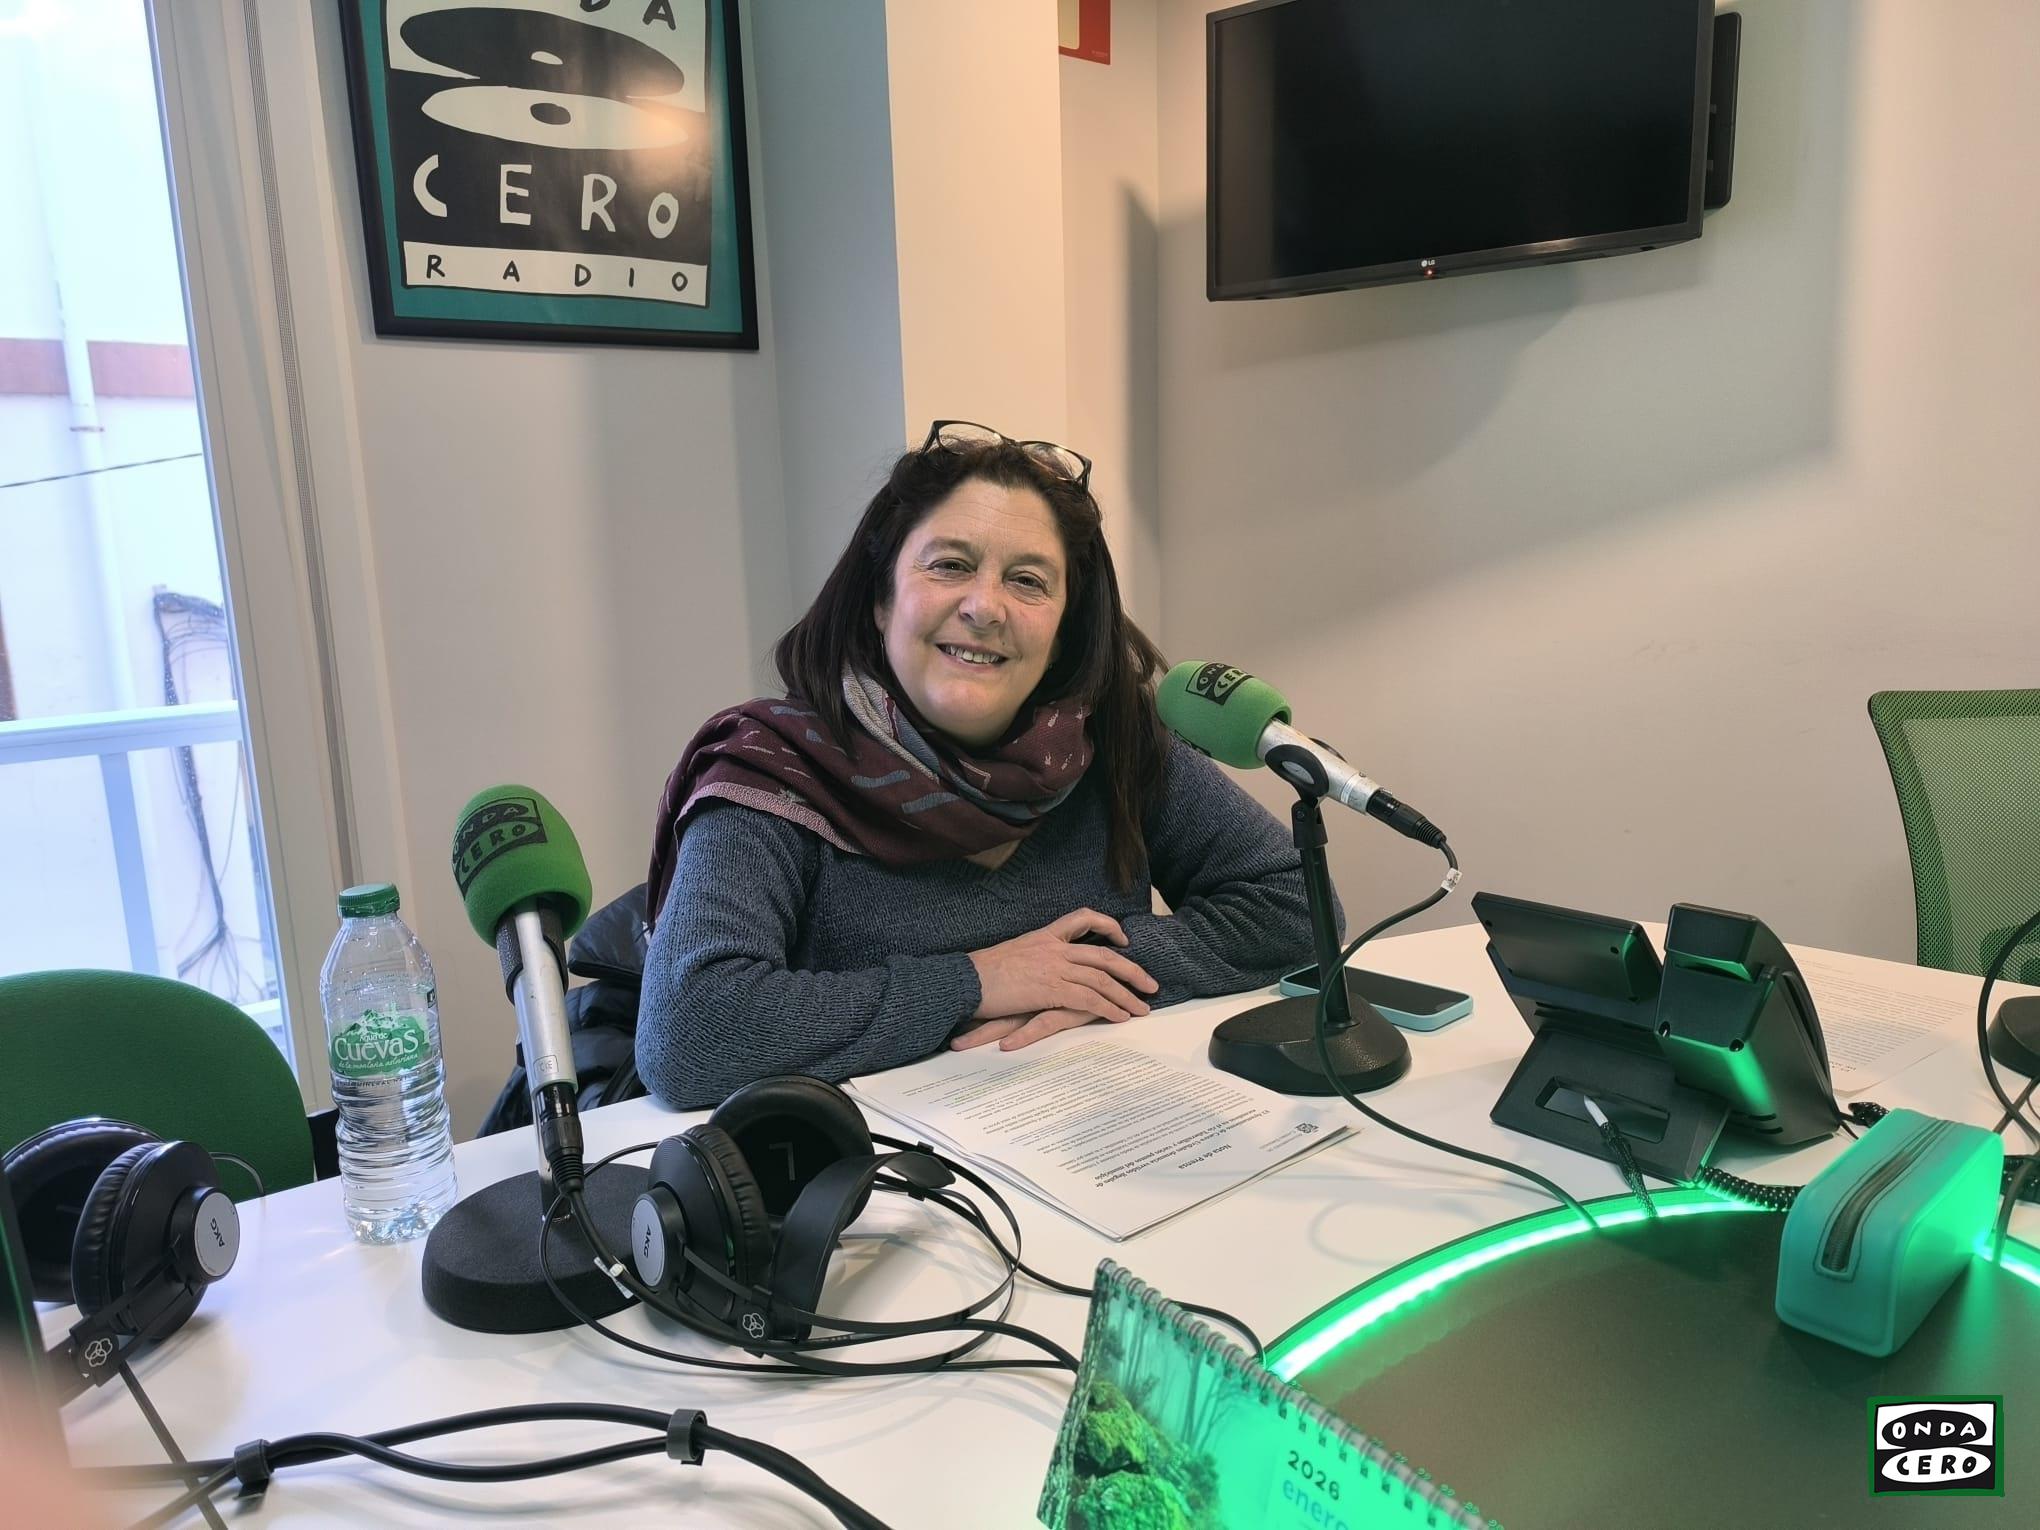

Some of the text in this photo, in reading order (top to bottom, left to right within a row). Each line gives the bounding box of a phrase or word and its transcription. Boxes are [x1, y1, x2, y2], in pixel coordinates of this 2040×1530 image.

[413, 154, 680, 240] CERO
[426, 254, 689, 293] RADIO
[461, 824, 526, 873] CERO
[210, 1217, 226, 1248] AKG
[643, 1223, 652, 1259] AKG
